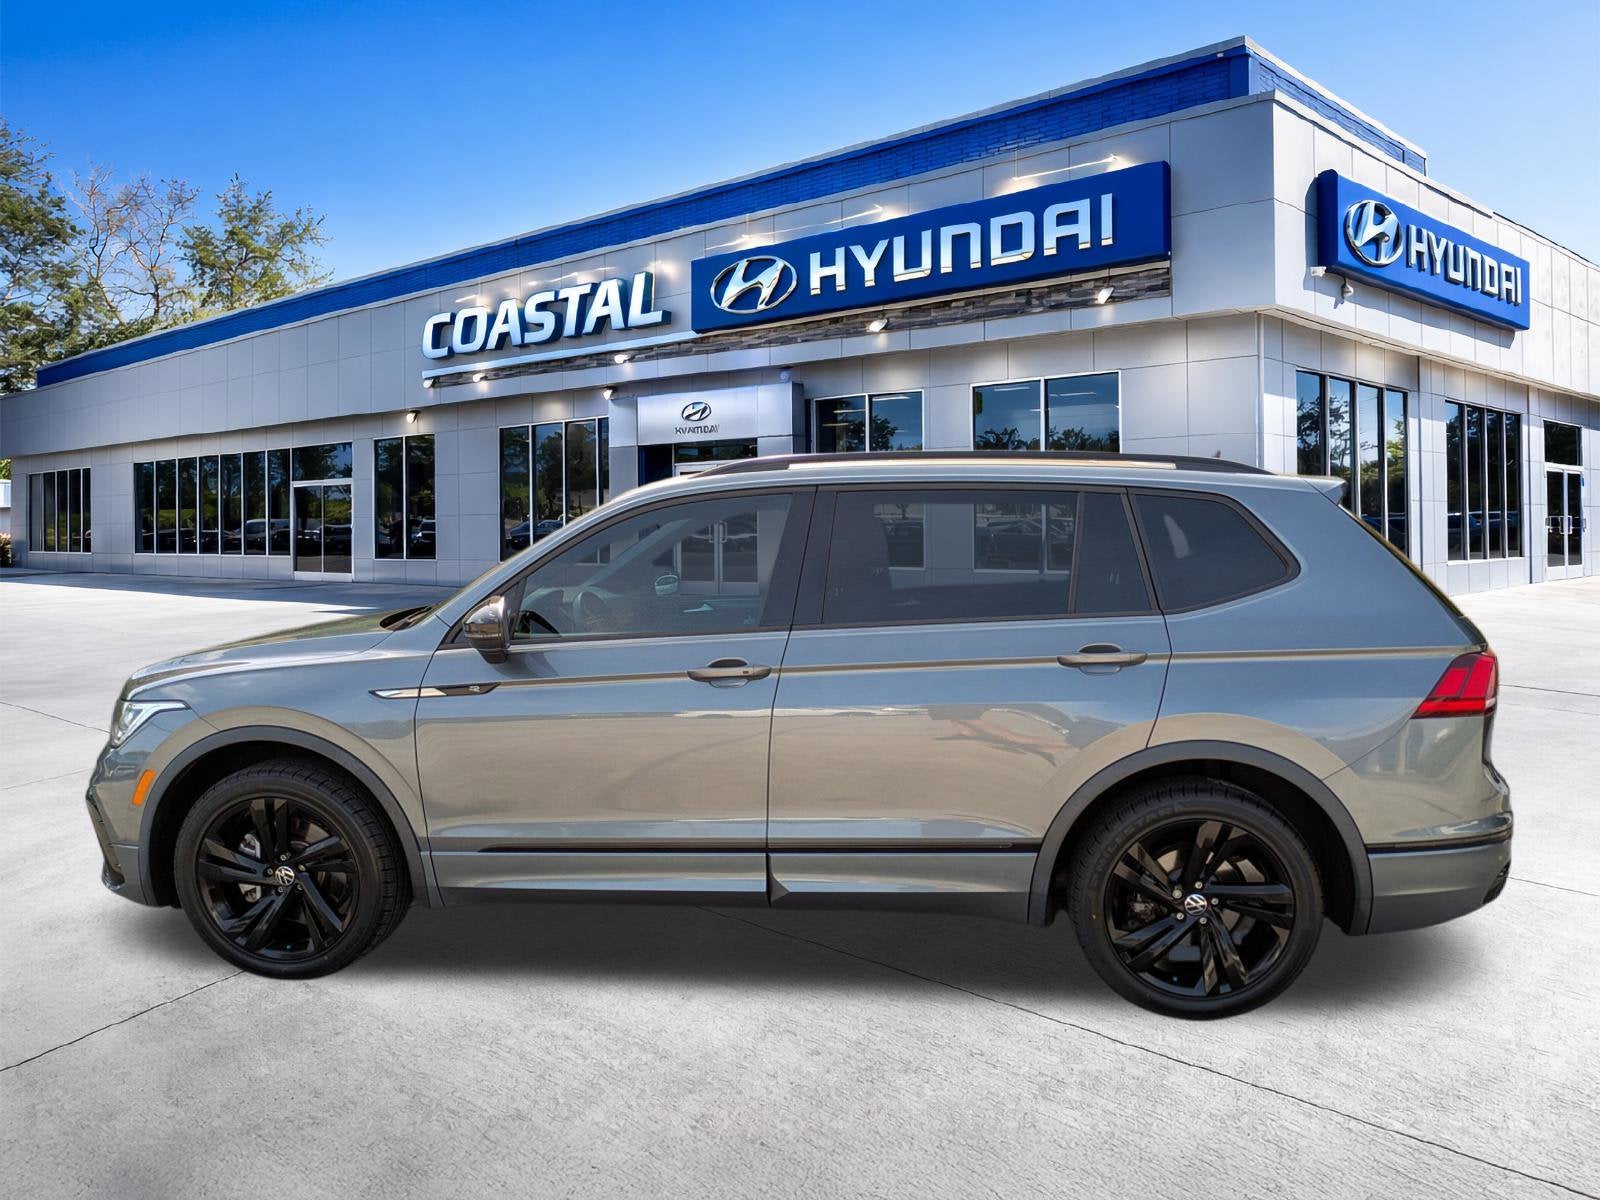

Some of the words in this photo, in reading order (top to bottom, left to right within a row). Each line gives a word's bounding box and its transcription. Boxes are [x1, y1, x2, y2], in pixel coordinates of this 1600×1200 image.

[810, 193, 1113, 295] HYUNDAI
[1406, 224, 1522, 306] HYUNDAI
[422, 270, 668, 360] COASTAL
